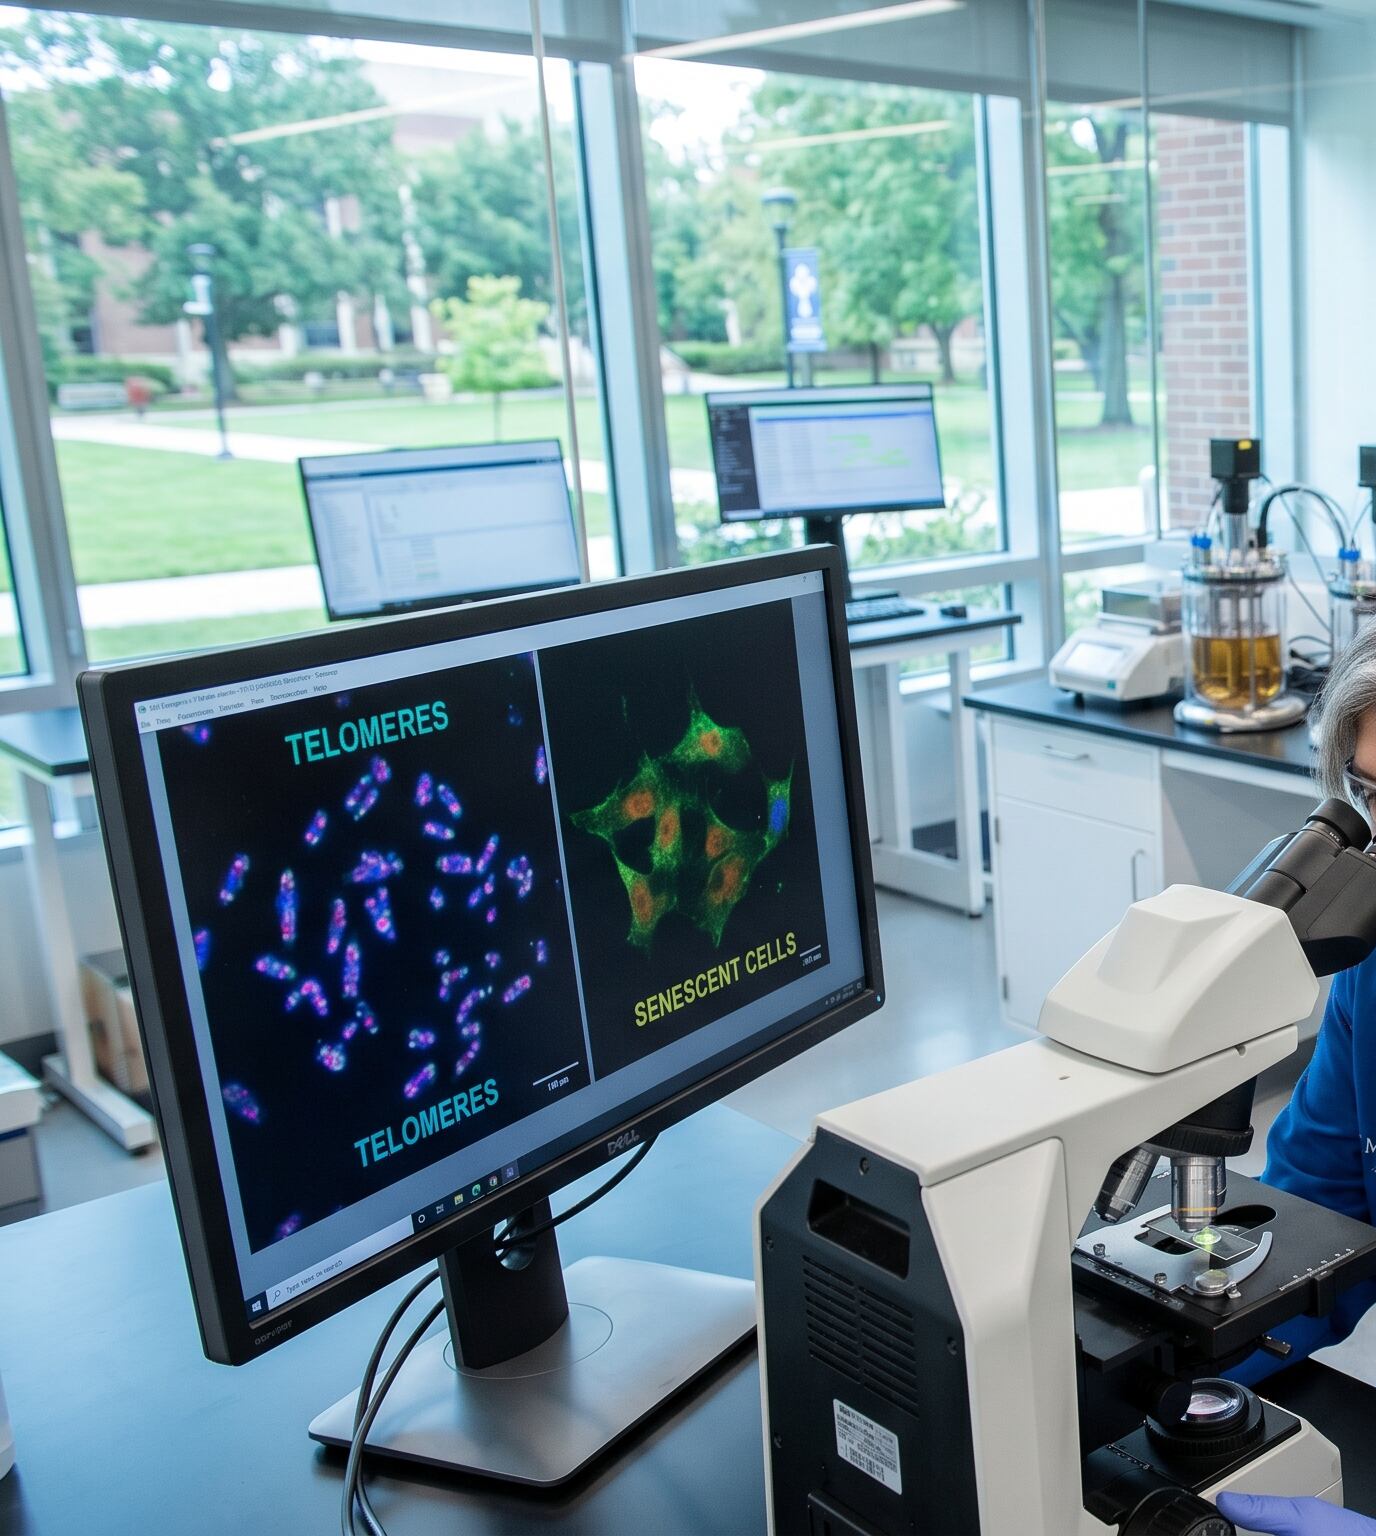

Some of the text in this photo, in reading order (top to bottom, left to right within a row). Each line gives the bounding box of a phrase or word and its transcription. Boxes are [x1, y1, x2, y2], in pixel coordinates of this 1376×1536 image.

[284, 700, 449, 766] TELOMERES
[634, 931, 797, 1027] SENESCENT CELLS
[354, 1079, 500, 1169] TELOMERES
